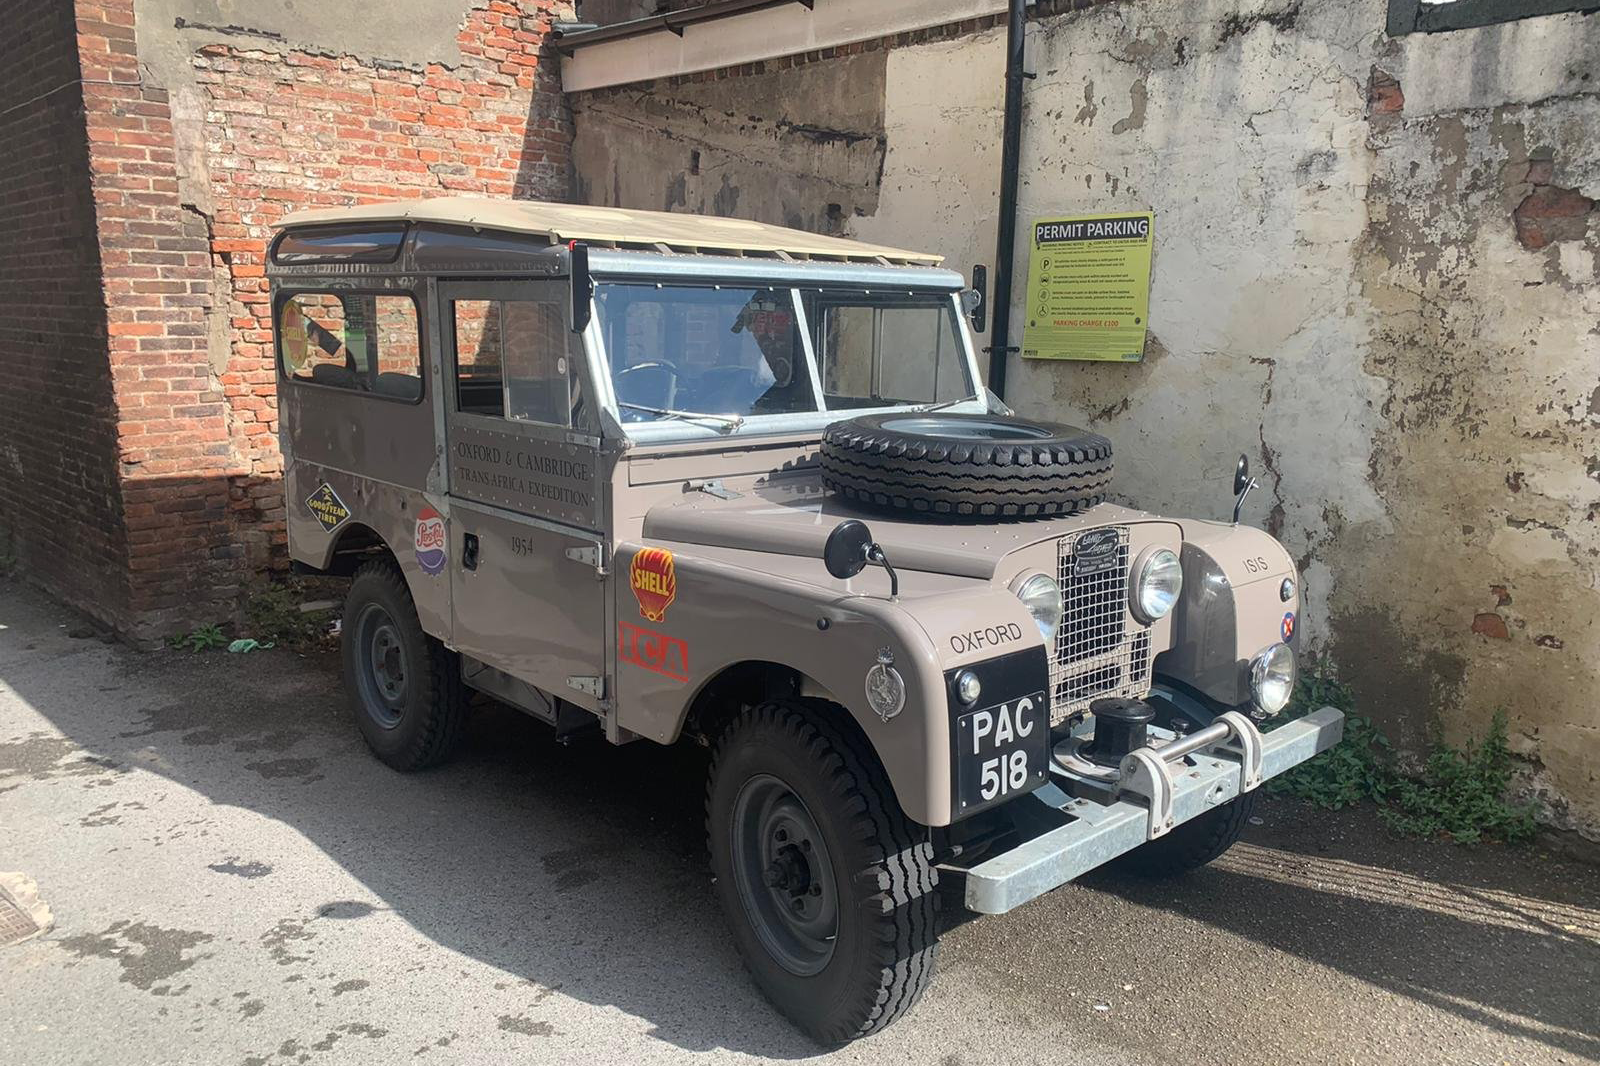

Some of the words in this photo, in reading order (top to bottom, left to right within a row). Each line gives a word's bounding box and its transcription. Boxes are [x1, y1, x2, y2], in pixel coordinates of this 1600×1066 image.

[1037, 223, 1084, 239] PERMIT
[1087, 220, 1148, 236] PARKING
[457, 442, 500, 464] OXFORD
[505, 451, 512, 466] &
[517, 452, 589, 482] CAMBRIDGE
[528, 481, 589, 507] EXPEDITION
[309, 499, 346, 517] GOODYEAR
[318, 511, 337, 525] TIRES
[511, 536, 534, 557] 1954
[1242, 556, 1269, 574] ISIS
[634, 568, 670, 597] SHELL
[950, 622, 1022, 654] OXFORD
[621, 625, 686, 679] ICA
[972, 698, 1034, 755] PAC
[980, 750, 1028, 801] 518
